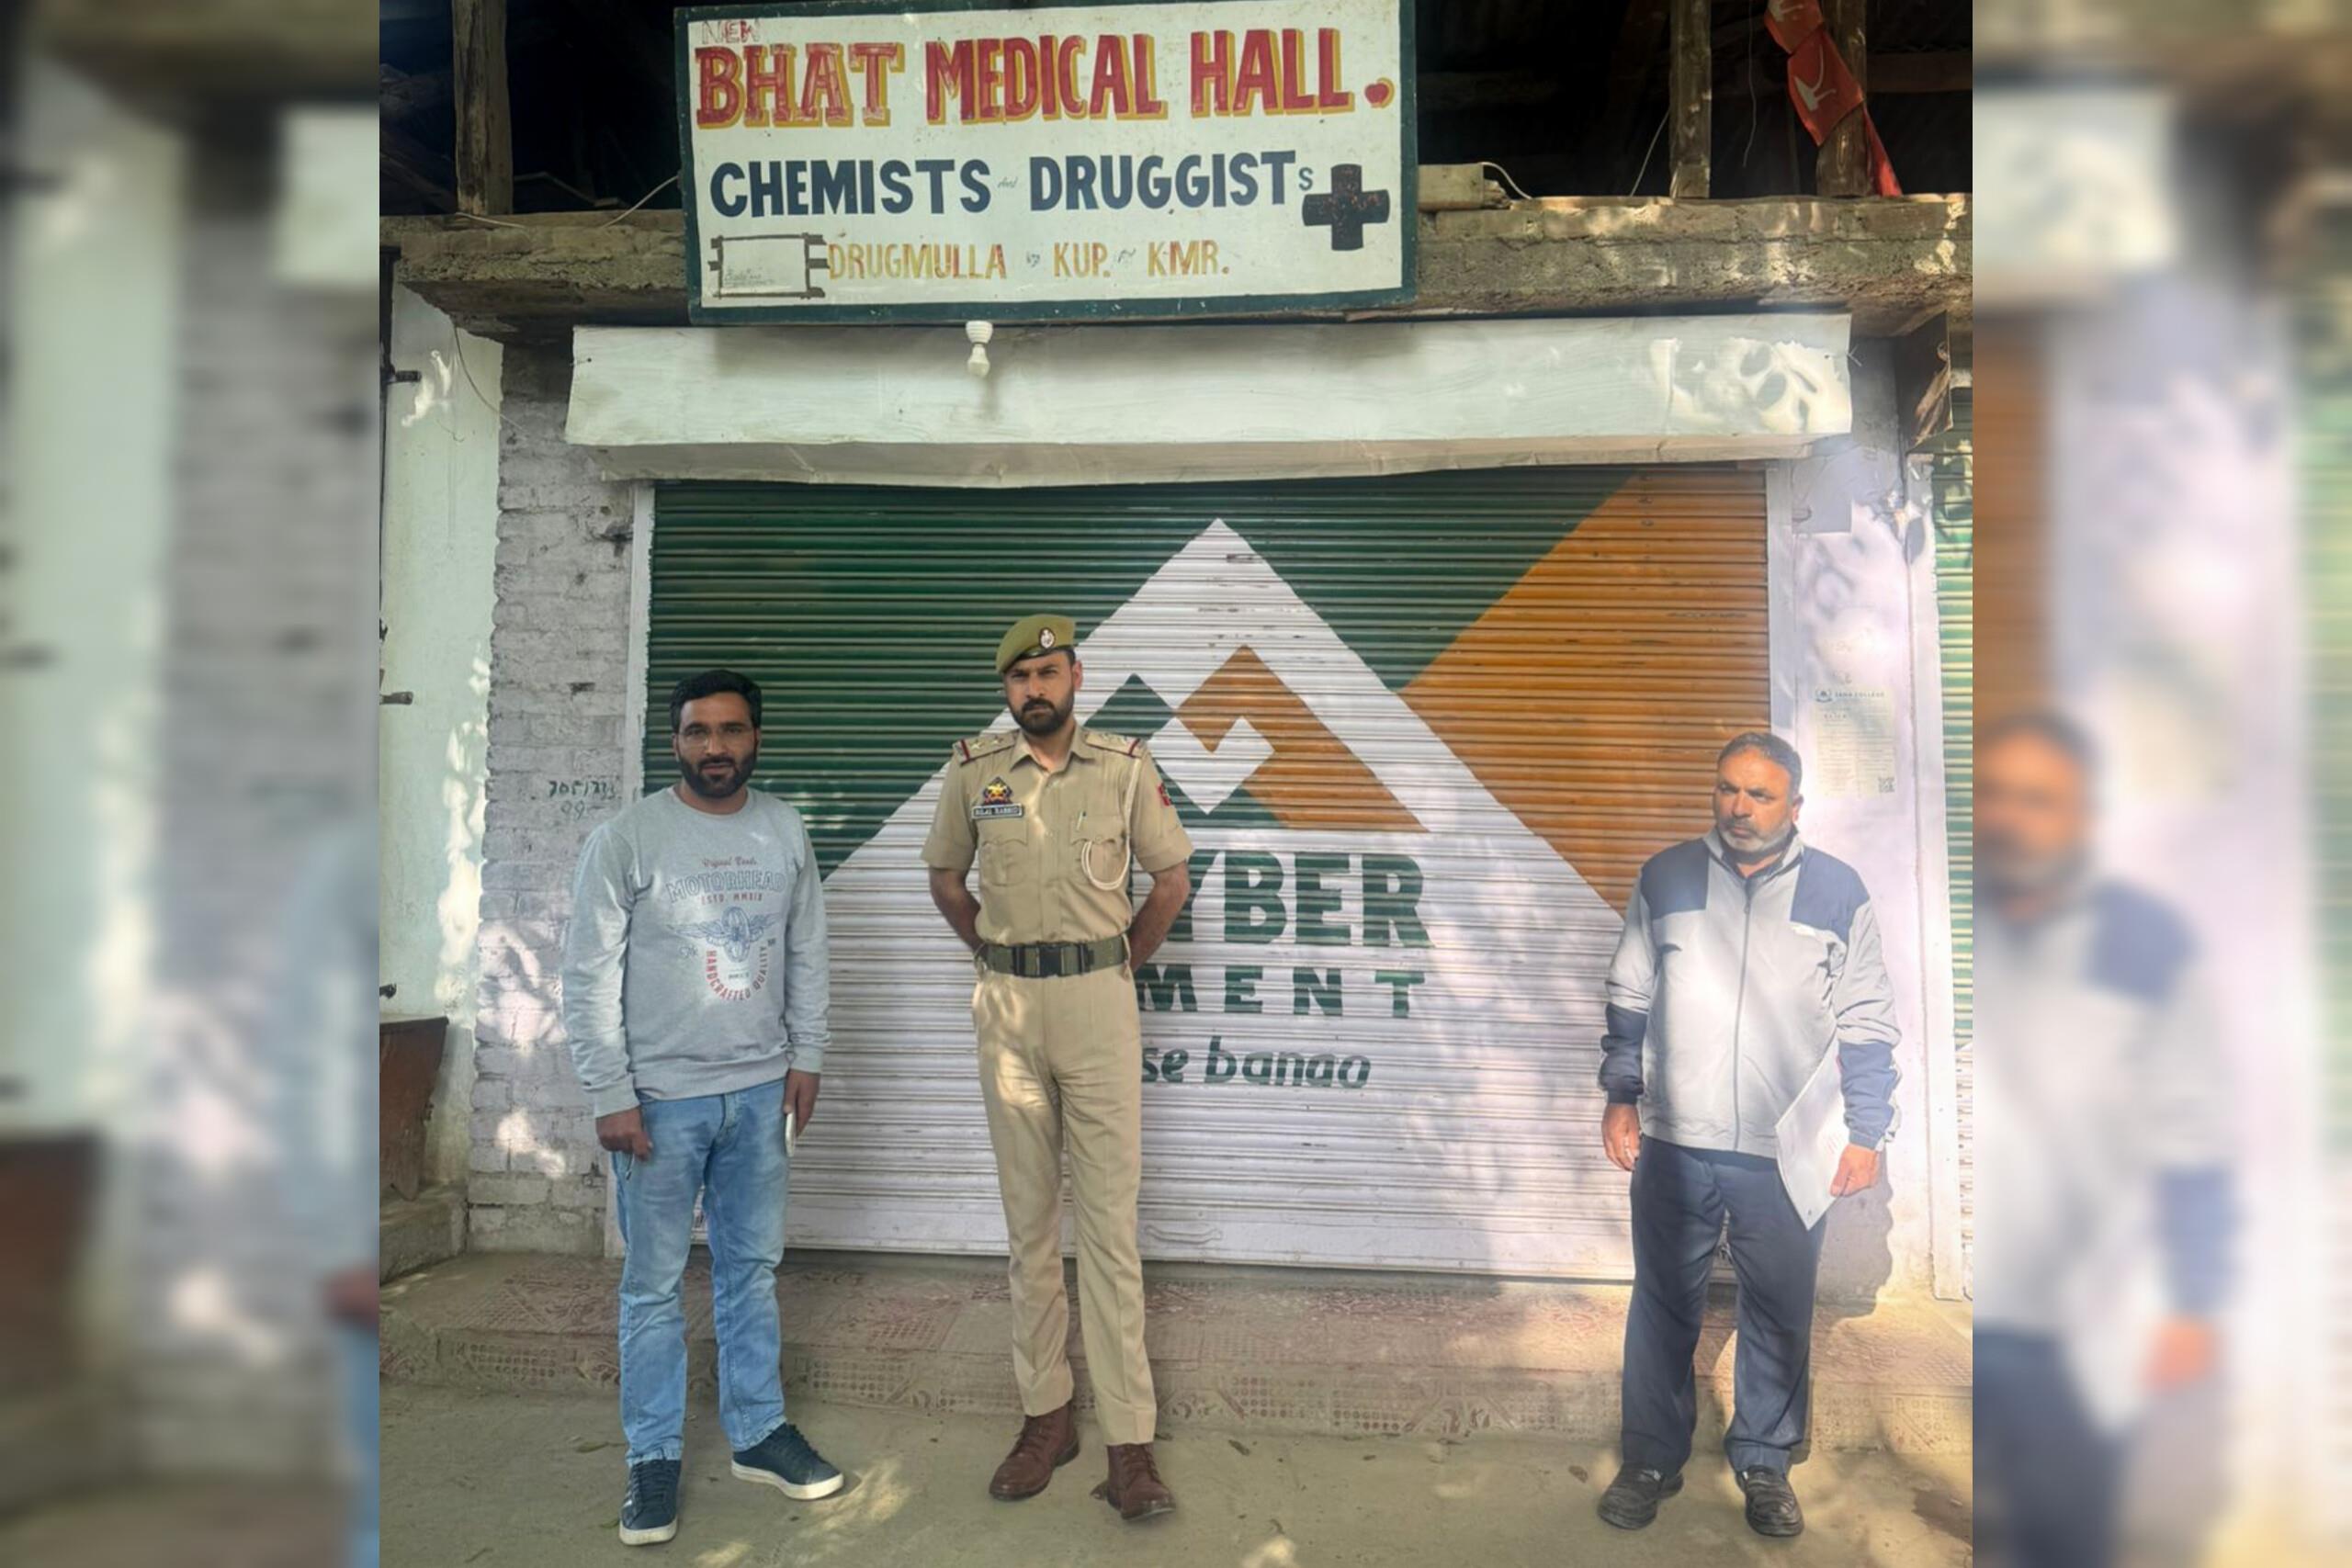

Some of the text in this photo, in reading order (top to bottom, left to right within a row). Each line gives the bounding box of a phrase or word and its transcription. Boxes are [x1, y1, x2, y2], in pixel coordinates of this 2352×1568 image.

[701, 18, 761, 44] NEW
[695, 42, 905, 130] BHAT
[925, 34, 1168, 125] MEDICAL
[710, 159, 991, 218] CHEMISTS
[829, 243, 1007, 280] DRUGMULLA
[666, 871, 788, 904] MOTORHEAD
[1166, 849, 1437, 948] YBER
[706, 950, 752, 1001] HANDCRAFTED
[1135, 964, 1425, 1019] MENT
[1141, 1035, 1372, 1089] se banao
